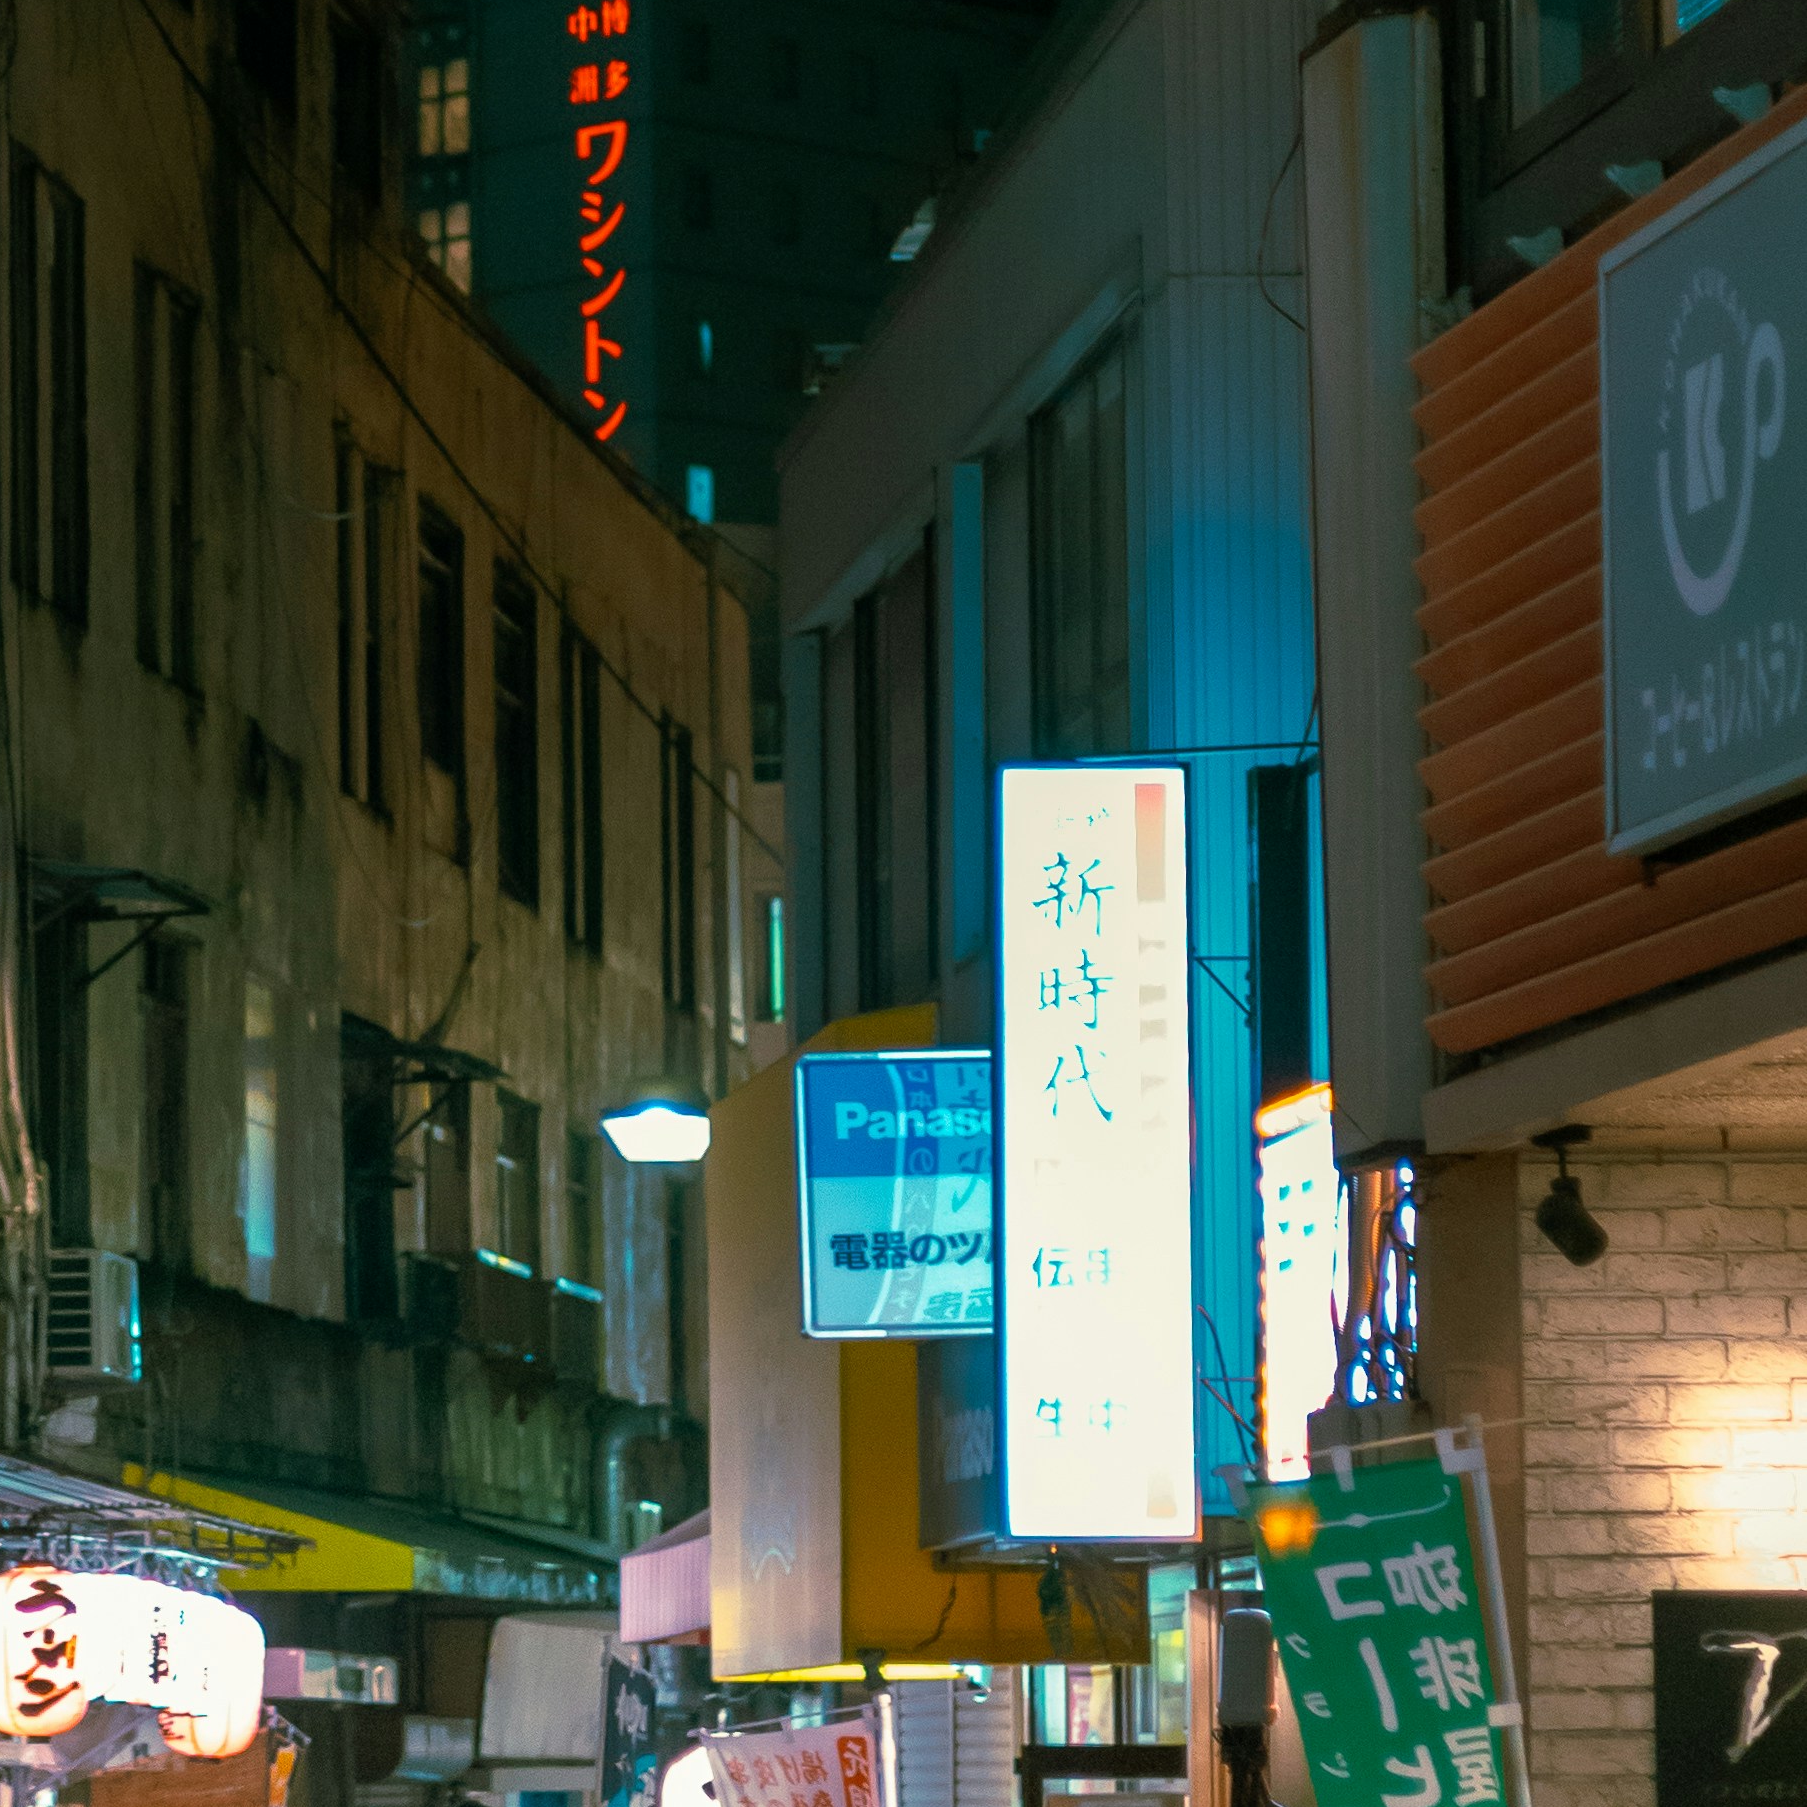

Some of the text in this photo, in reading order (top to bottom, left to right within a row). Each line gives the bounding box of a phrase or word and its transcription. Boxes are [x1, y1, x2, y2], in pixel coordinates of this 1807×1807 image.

[575, 119, 629, 443] ワシントン
[1032, 851, 1116, 1126] 新時代
[835, 1101, 991, 1139] Panas
[830, 1232, 992, 1271] 電器のツ
[14, 1578, 81, 1718] ラーメン
